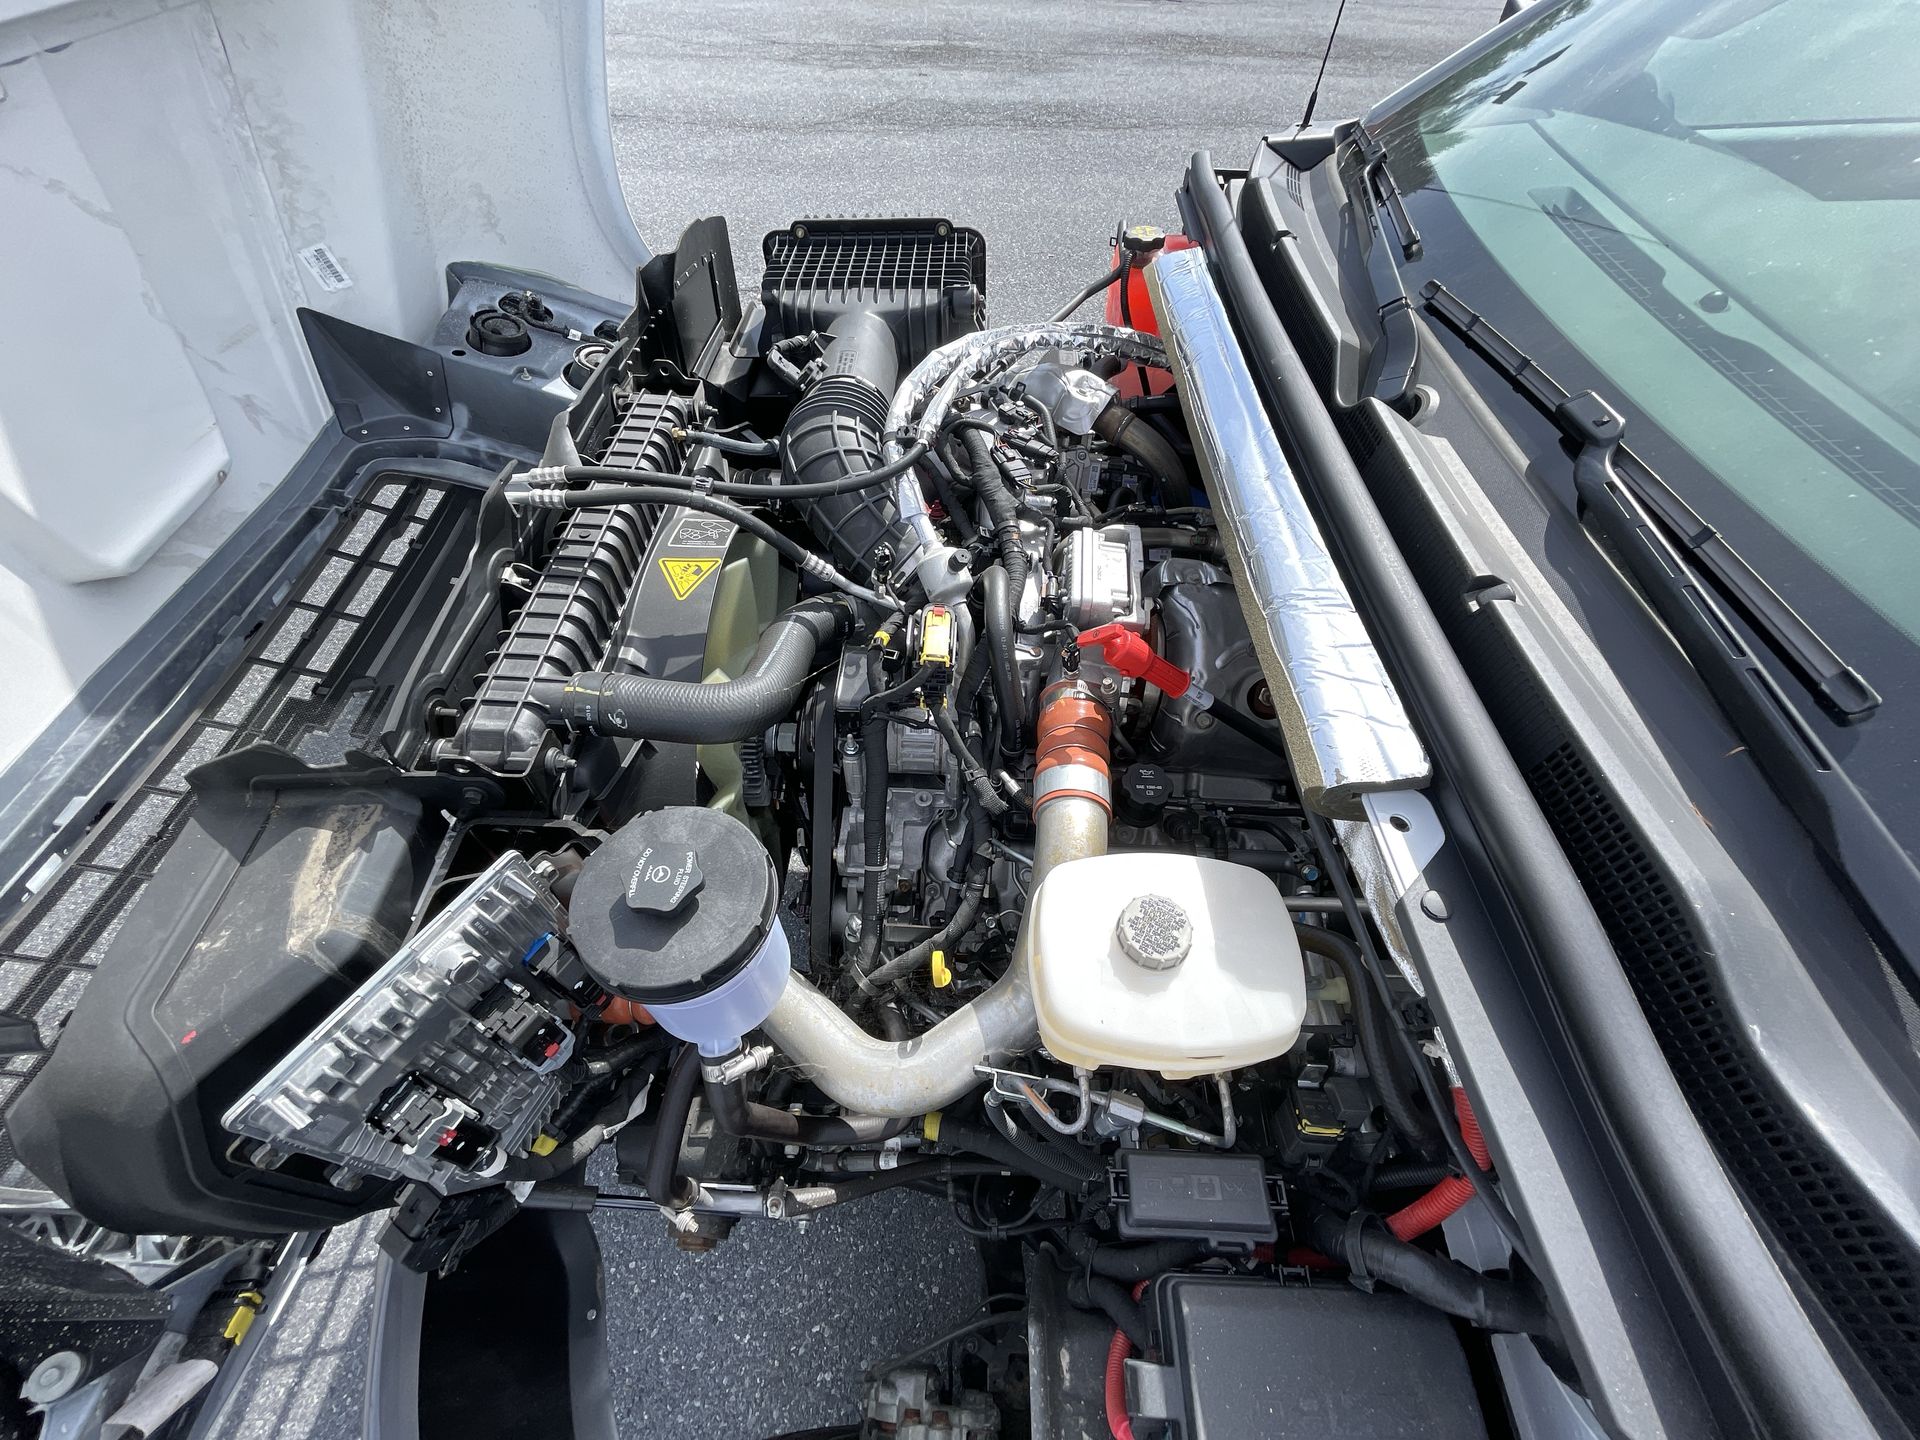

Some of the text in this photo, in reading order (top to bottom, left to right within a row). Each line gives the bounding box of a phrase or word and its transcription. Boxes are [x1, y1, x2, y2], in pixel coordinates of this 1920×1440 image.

[628, 848, 653, 898] DO NOT OVERFILL
[670, 851, 694, 903] POWER STEERING
[673, 868, 684, 885] FLUID
